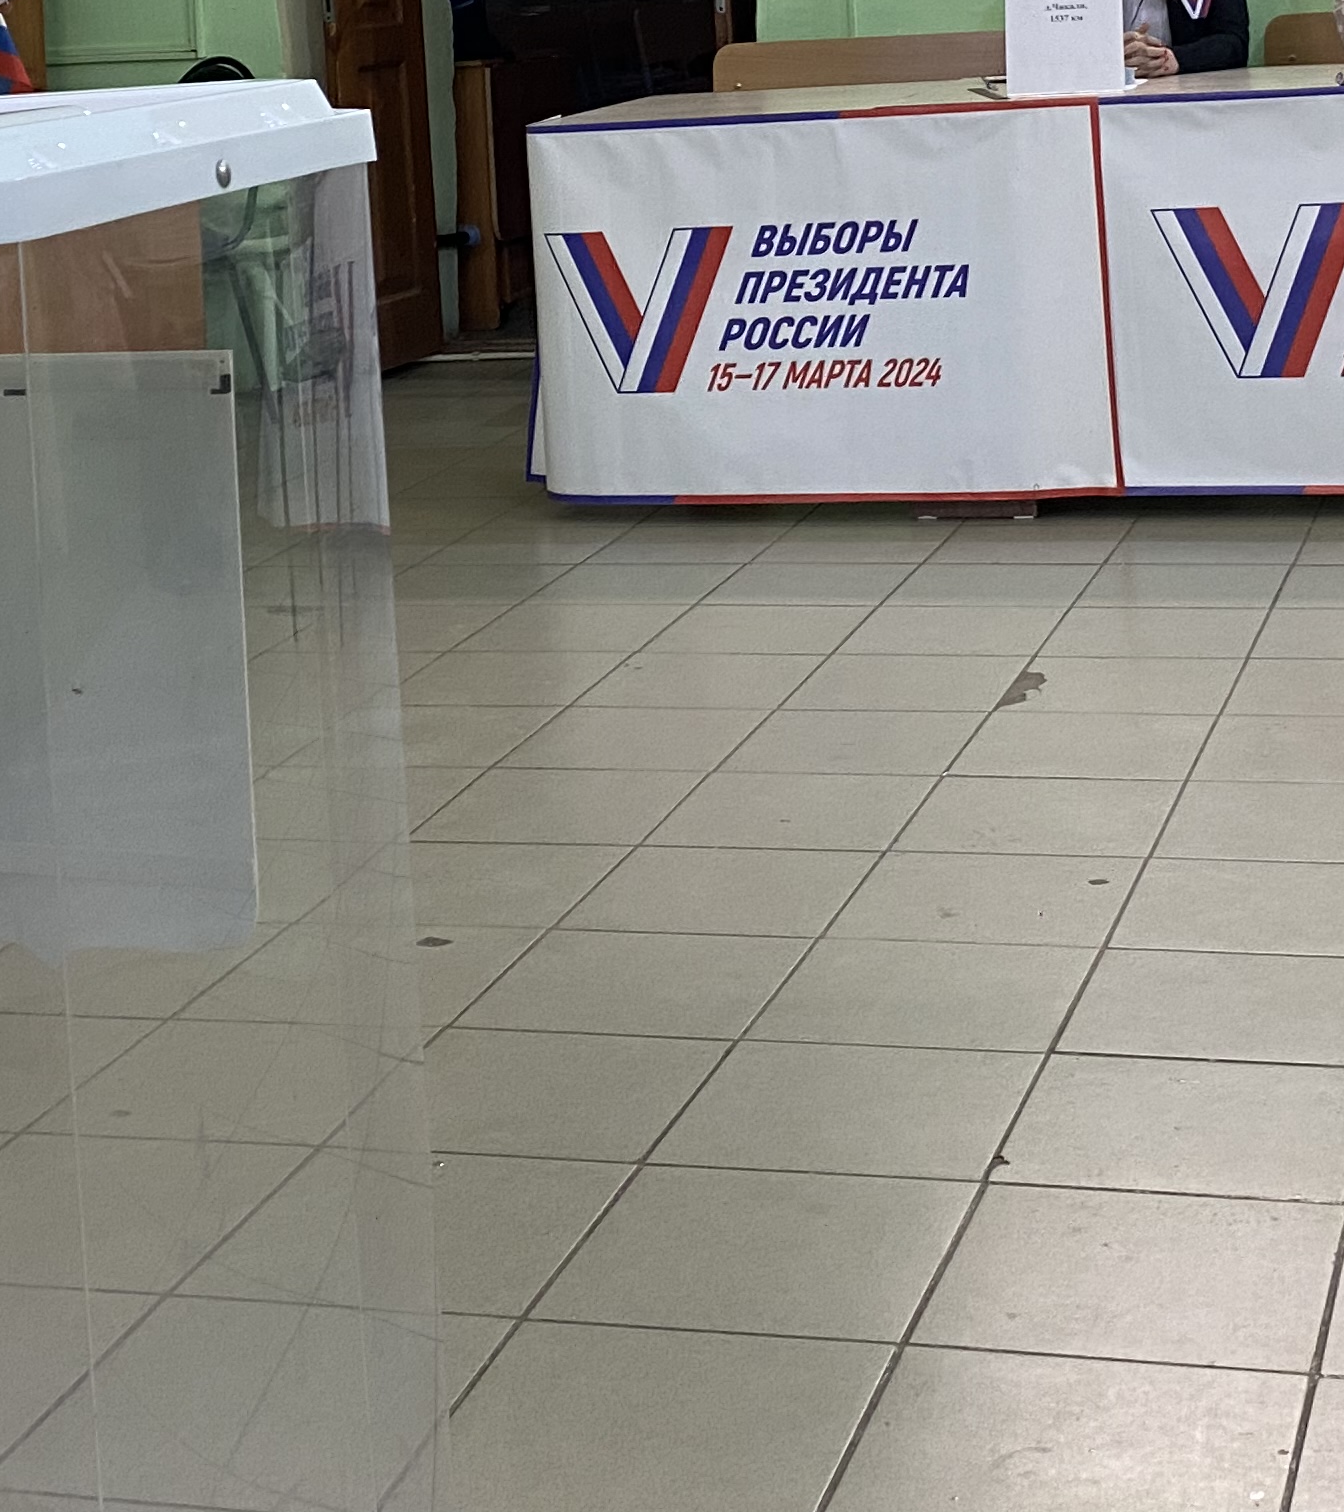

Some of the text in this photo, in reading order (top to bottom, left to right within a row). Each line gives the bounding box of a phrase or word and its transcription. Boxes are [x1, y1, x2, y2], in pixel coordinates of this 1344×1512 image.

[750, 218, 919, 258] ВЫБОРЫ
[734, 263, 971, 306] ПРЕЗИДЕНТА
[718, 313, 871, 351] РОССИИ
[782, 358, 872, 390] МАРТА
[877, 356, 943, 388] 2024
